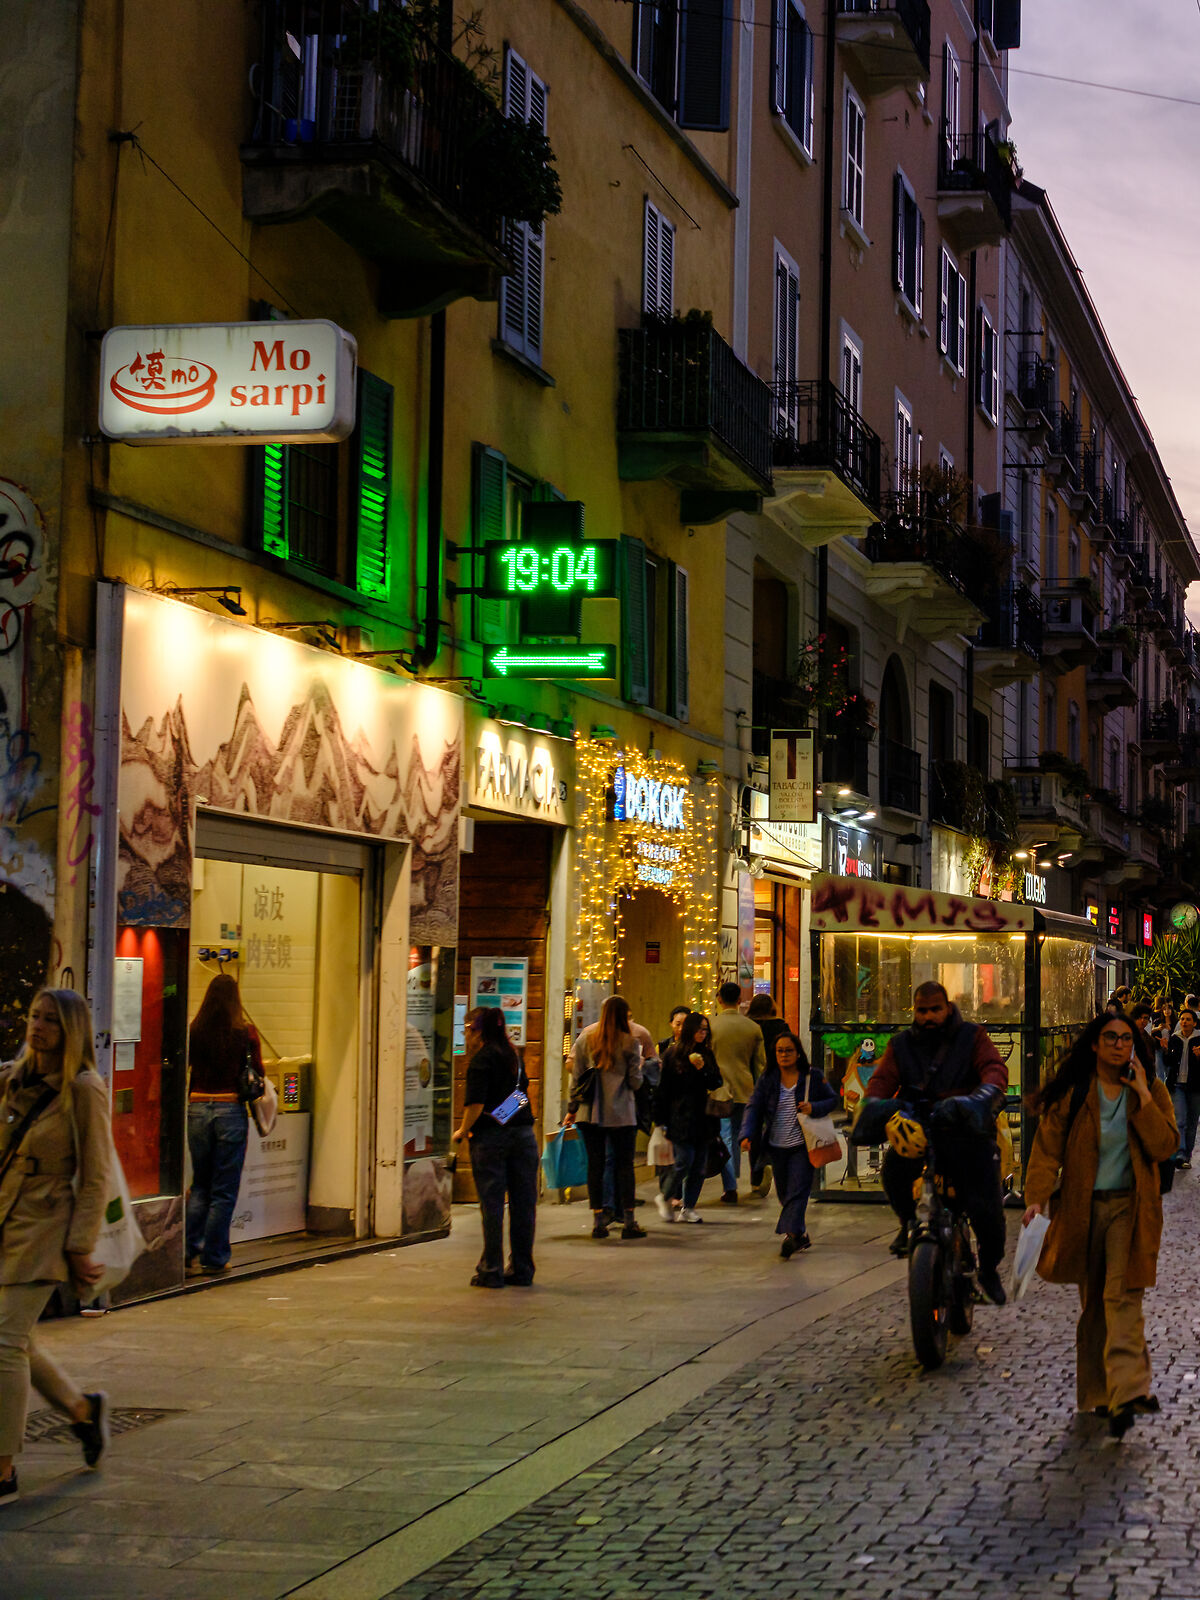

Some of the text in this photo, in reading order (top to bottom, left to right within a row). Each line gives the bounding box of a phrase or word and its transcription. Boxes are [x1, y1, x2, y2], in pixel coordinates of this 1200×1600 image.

[250, 340, 310, 371] Mo
[171, 365, 199, 384] mo
[230, 373, 327, 416] sarpi
[501, 547, 598, 591] 19:04
[474, 747, 560, 807] FARMACIA
[772, 781, 812, 791] TABACCHI
